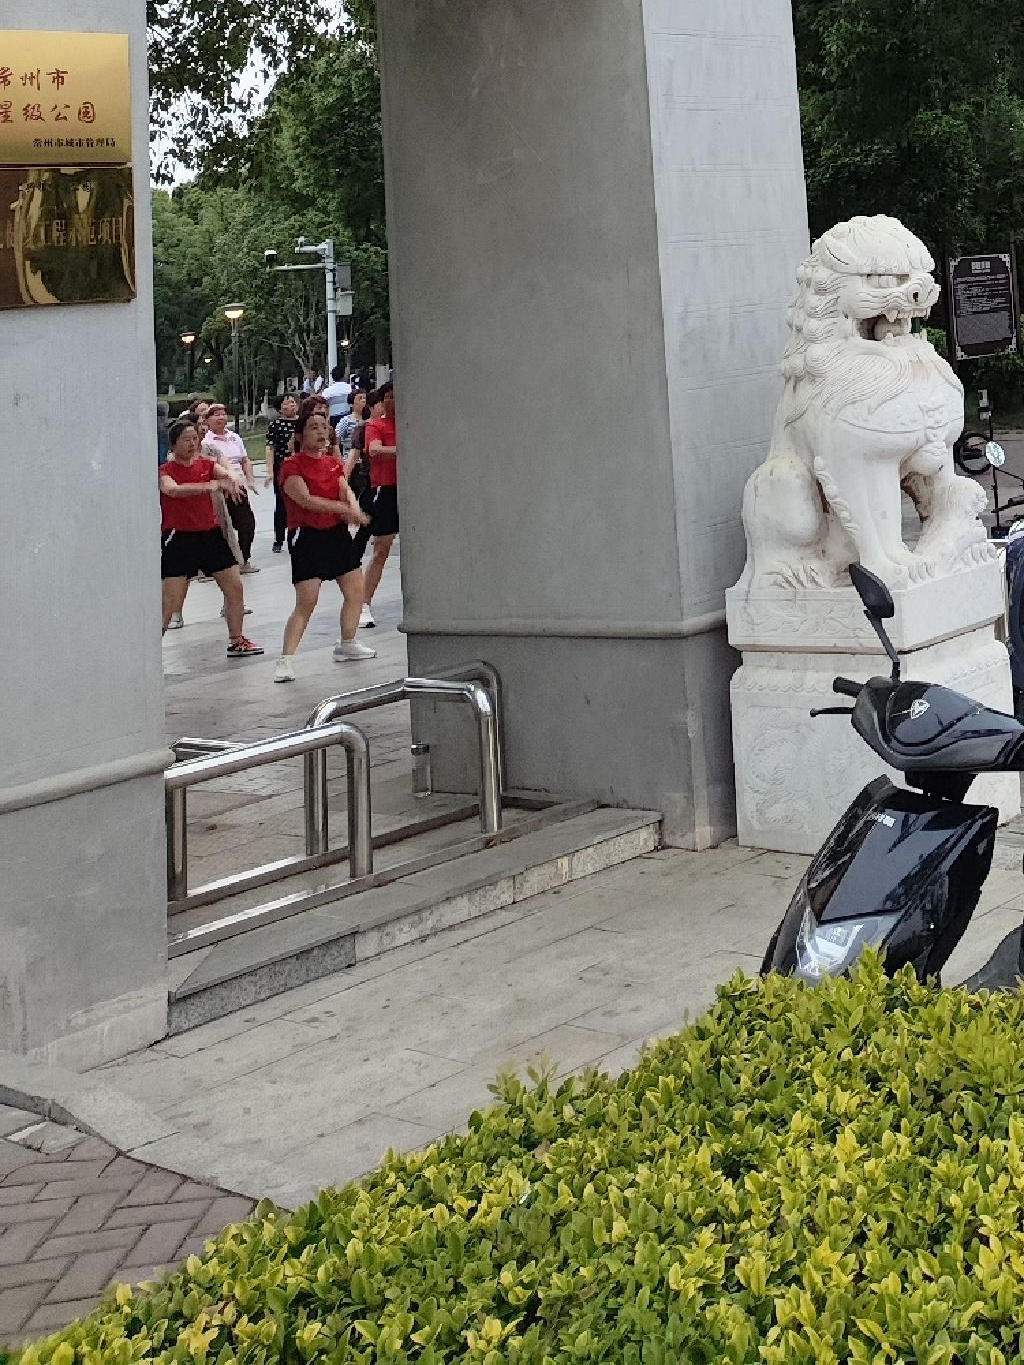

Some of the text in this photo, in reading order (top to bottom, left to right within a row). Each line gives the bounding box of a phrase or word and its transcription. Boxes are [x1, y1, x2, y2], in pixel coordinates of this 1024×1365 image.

[0, 67, 68, 91] 常州市
[0, 101, 96, 123] 星级公园
